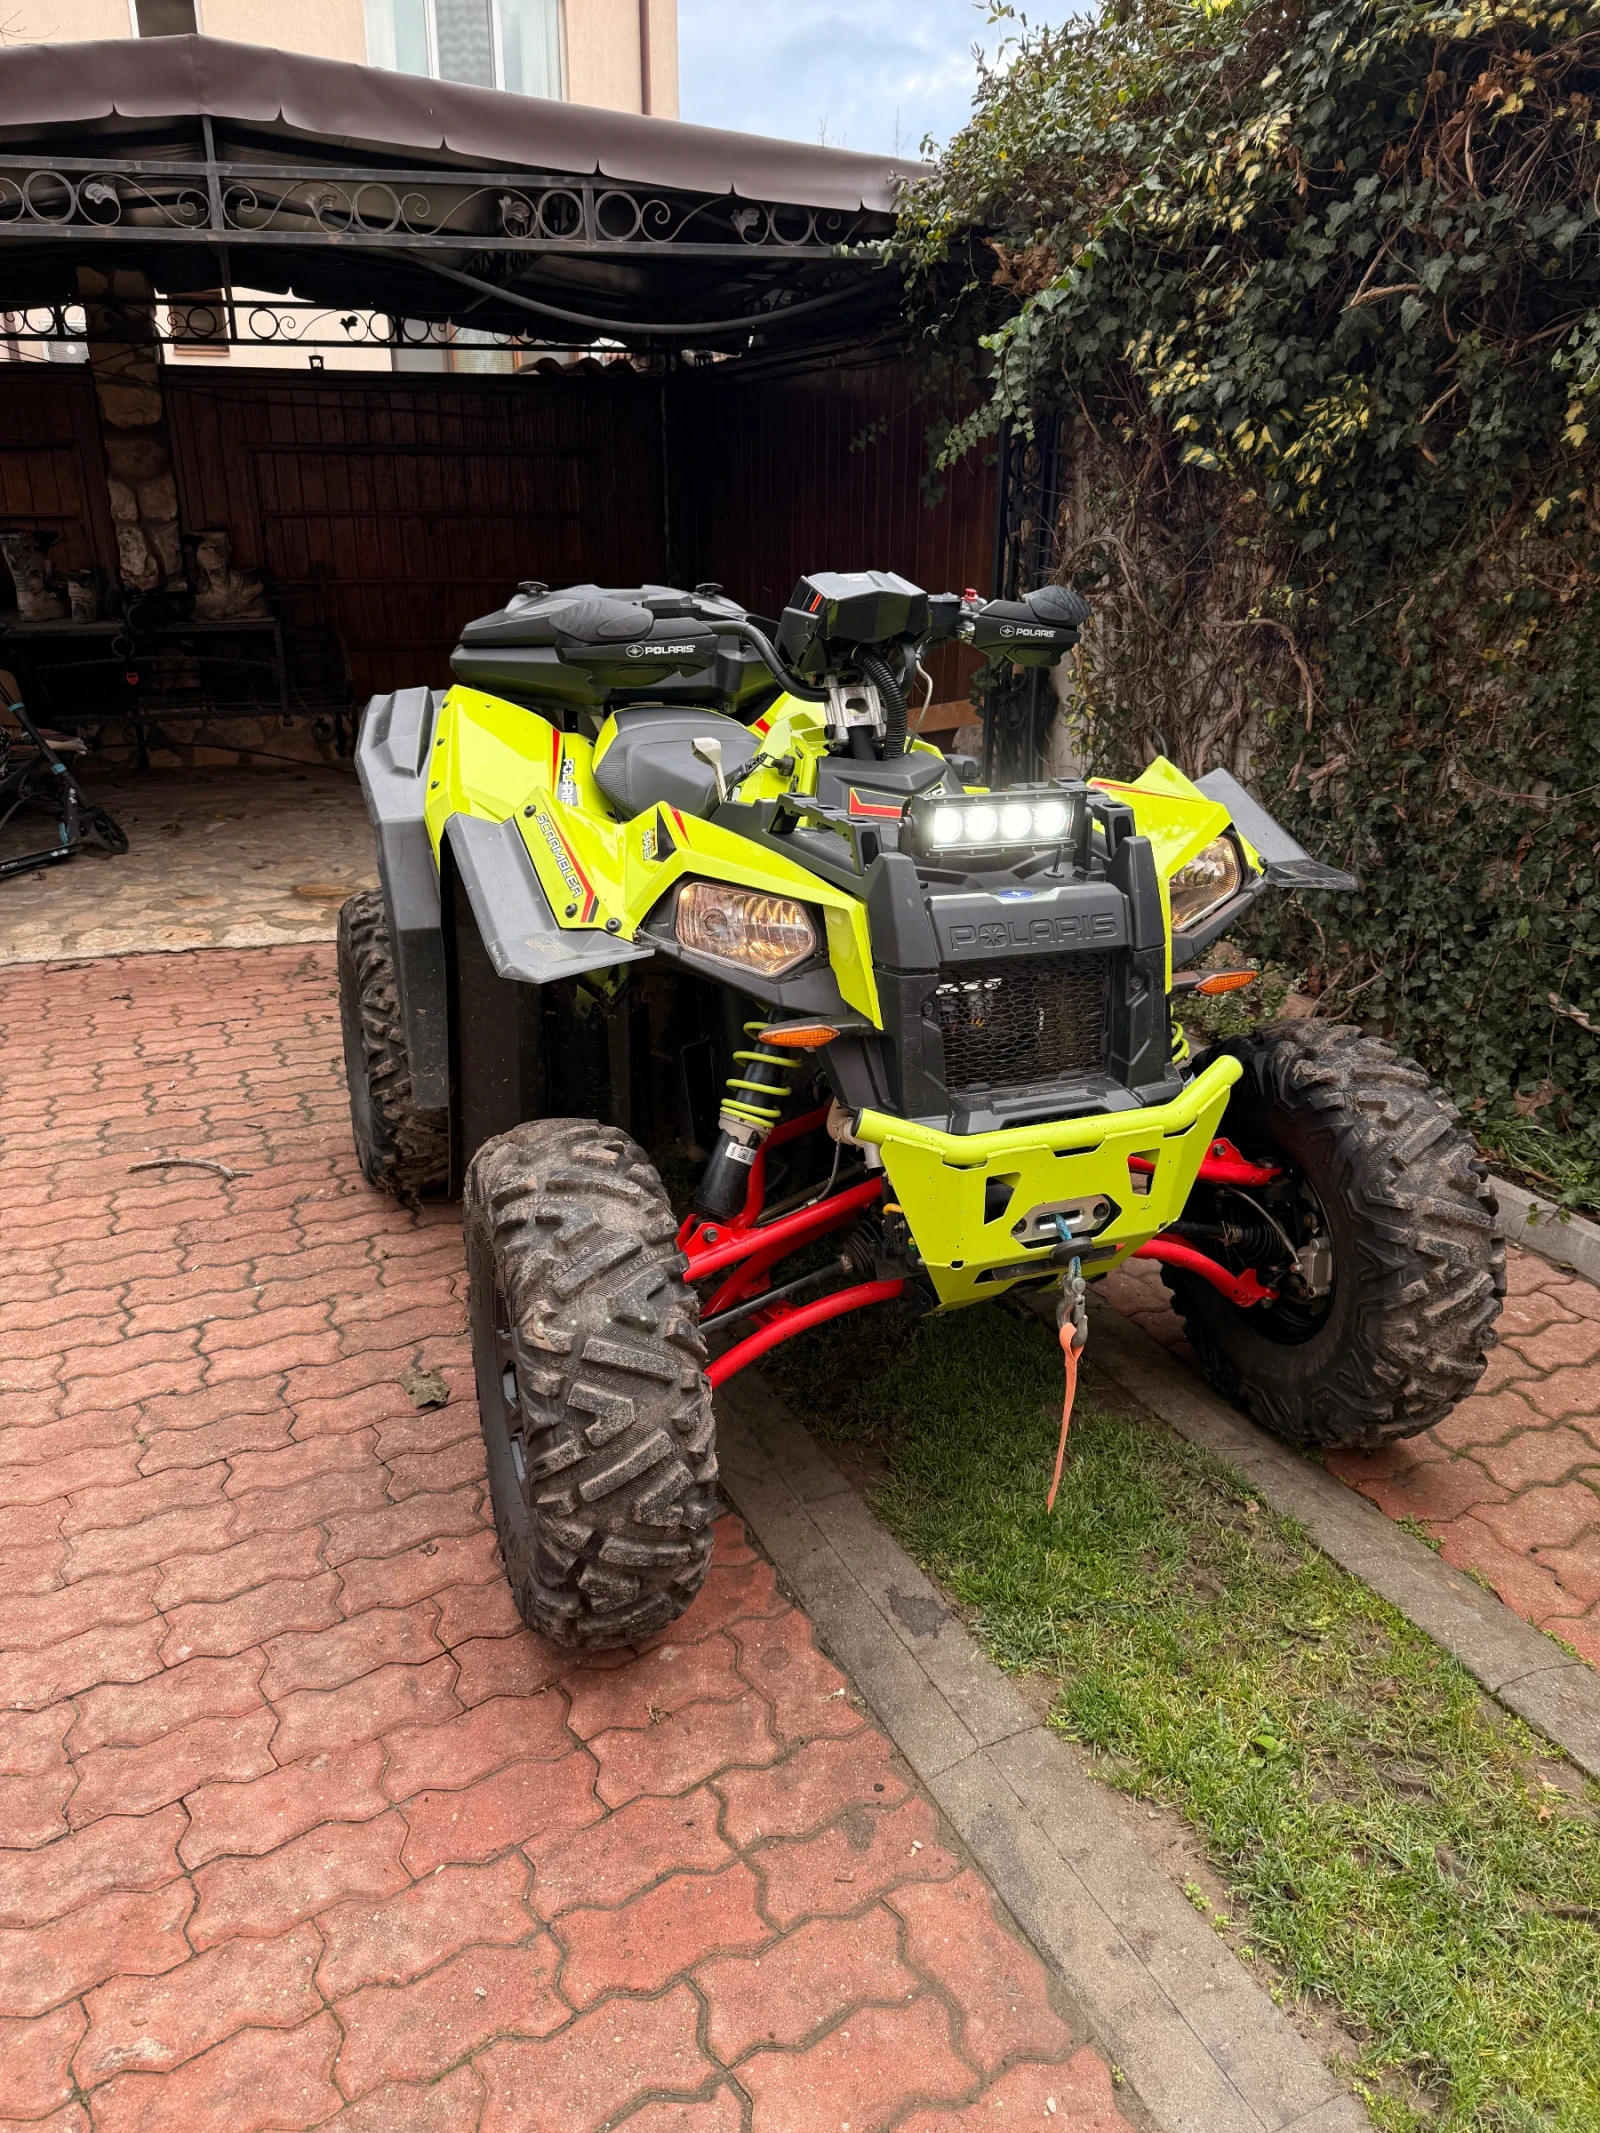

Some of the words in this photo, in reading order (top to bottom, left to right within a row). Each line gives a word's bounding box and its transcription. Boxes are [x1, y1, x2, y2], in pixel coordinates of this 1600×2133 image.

[1016, 628, 1056, 638] POLARIS
[645, 644, 696, 655] POLARIS
[536, 811, 583, 898] SCRAMBLER
[949, 912, 1118, 951] POLARIS
